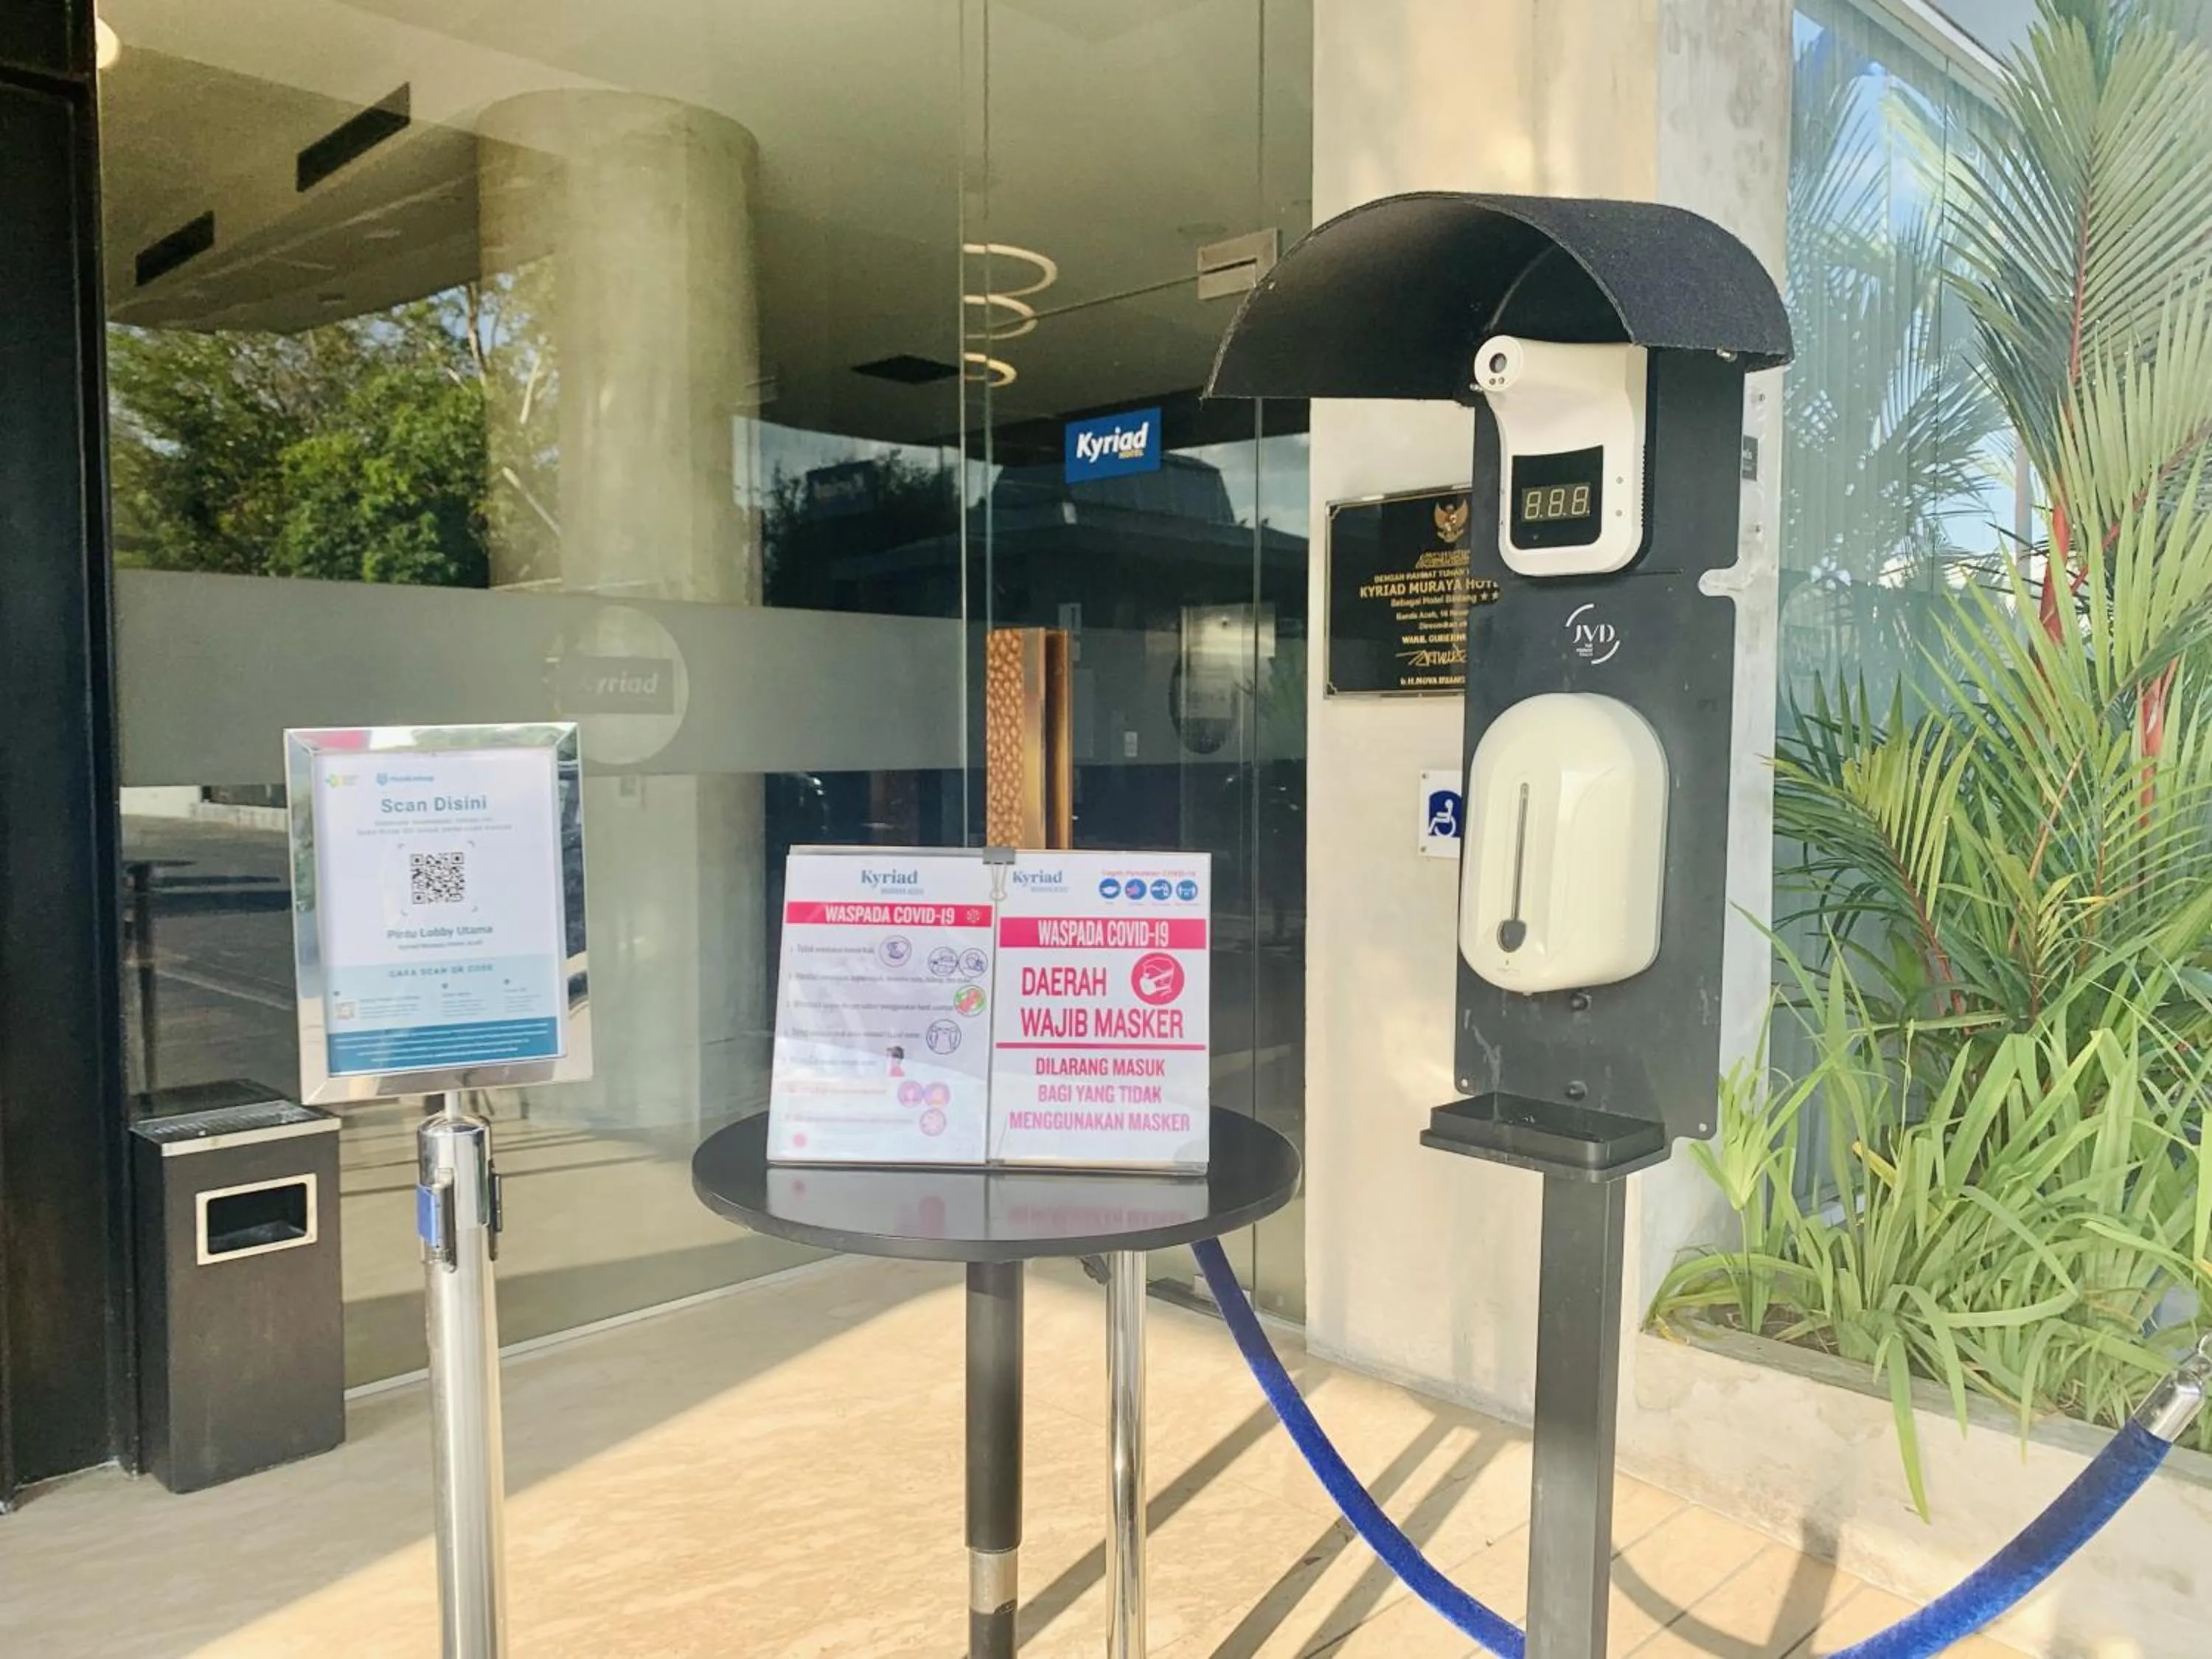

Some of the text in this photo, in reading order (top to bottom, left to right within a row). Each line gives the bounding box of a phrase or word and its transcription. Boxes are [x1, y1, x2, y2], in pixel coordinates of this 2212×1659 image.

[1076, 421, 1150, 463] Kyriad
[1360, 583, 1406, 599] KYRIAD
[1409, 579, 1462, 594] MURAYA
[1572, 625, 1615, 644] JVD
[579, 670, 658, 695] yriad
[380, 795, 487, 813] Scan Disini
[860, 869, 918, 887] Kyriad
[1012, 870, 1062, 885] Kyriad
[825, 905, 955, 925] WASPADA COVID-19
[420, 927, 453, 939] Lobby
[456, 925, 493, 935] Utama
[1037, 919, 1169, 947] WASPADA COVID-19
[1021, 967, 1107, 996] DAERAH
[1020, 1007, 1183, 1038] WAJIB MASKER
[1036, 1057, 1165, 1077] DILARANG MASUK
[1038, 1085, 1161, 1105] BAGI YANG TIDAK
[1009, 1113, 1190, 1132] MENGGUNAKAN MASKER
